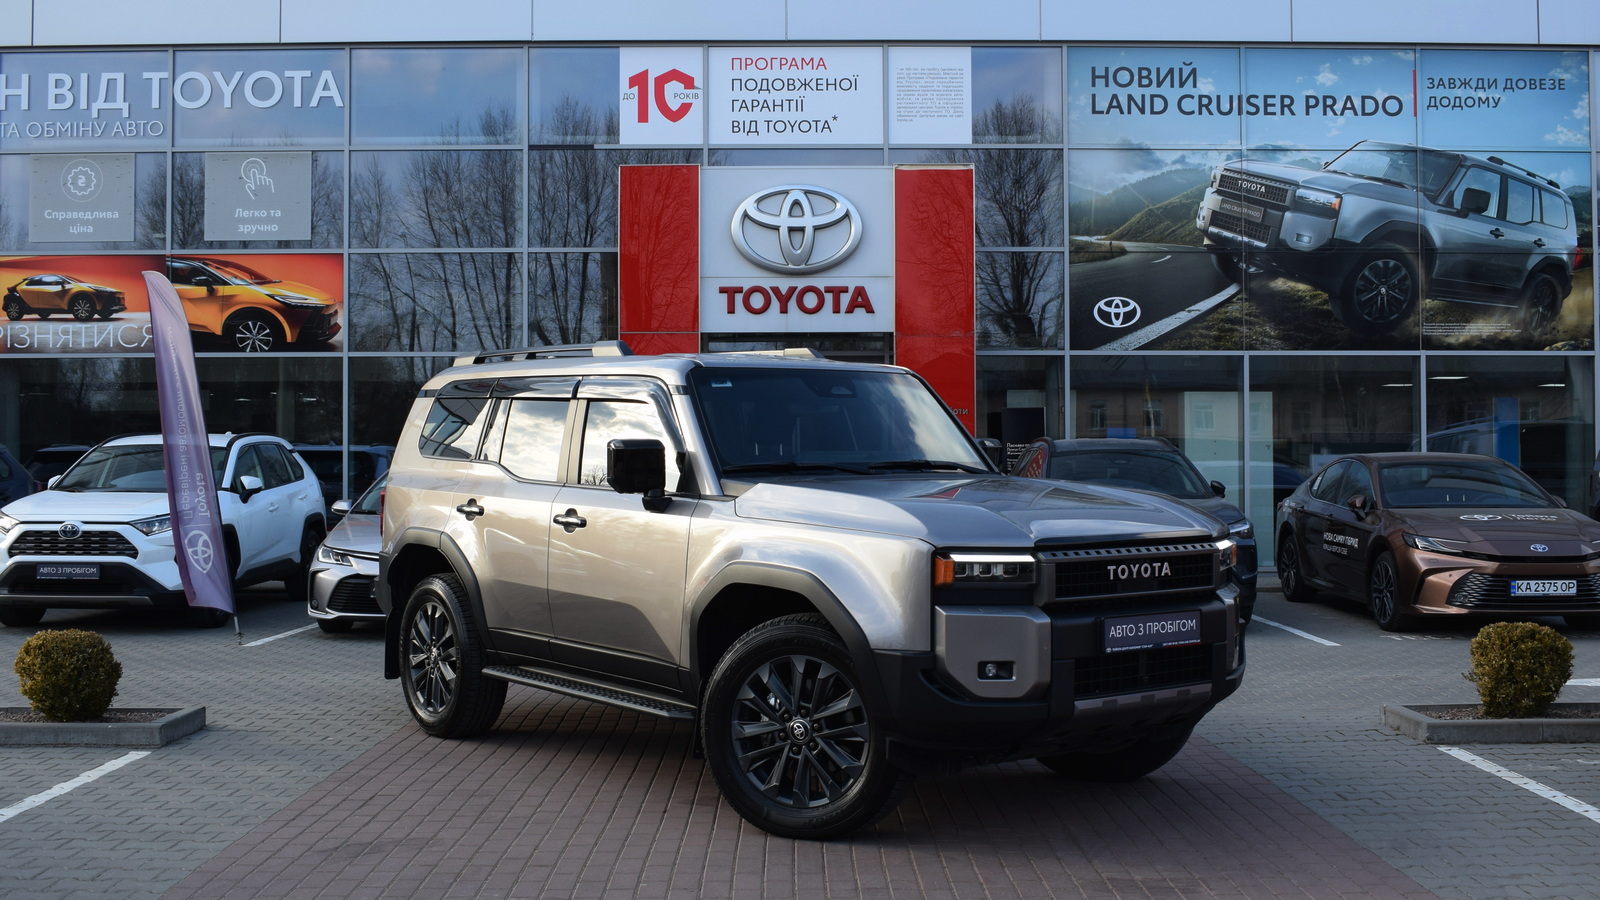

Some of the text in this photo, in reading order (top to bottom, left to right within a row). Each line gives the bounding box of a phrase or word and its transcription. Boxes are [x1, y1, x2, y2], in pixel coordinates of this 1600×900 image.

[731, 57, 827, 71] ПРОГРАМА
[1091, 61, 1197, 89] НОВИЙ
[731, 74, 859, 94] ПОДОВЖЕНОЇ
[1426, 77, 1566, 92] ЗАВЖДИ ДОВЕЗЕ
[48, 72, 129, 118] ВІД
[142, 70, 344, 109] TOYOTA
[622, 93, 636, 101] ДО
[731, 95, 806, 112] ГАРАНТІЇ
[1091, 93, 1404, 117] LAND CRUISER PRADO
[1426, 96, 1502, 110] ДОДОМУ
[0, 120, 165, 138] ТА ОБМІНУ АВТО
[731, 119, 759, 136] ВІД
[1238, 181, 1266, 192] TOYOTA
[44, 208, 120, 221] Справедлива
[234, 207, 282, 220] Легко та
[69, 223, 94, 234] ціна
[238, 222, 279, 234] зручно
[718, 285, 876, 315] TOYOTA
[0, 324, 153, 348] ІЗНЯТИСЯ
[1107, 562, 1171, 580] TOYOTA
[1516, 582, 1576, 593] KA 2375 OP
[1109, 624, 1136, 638] АВТО
[1146, 619, 1196, 634] ПРОБІГОМ
